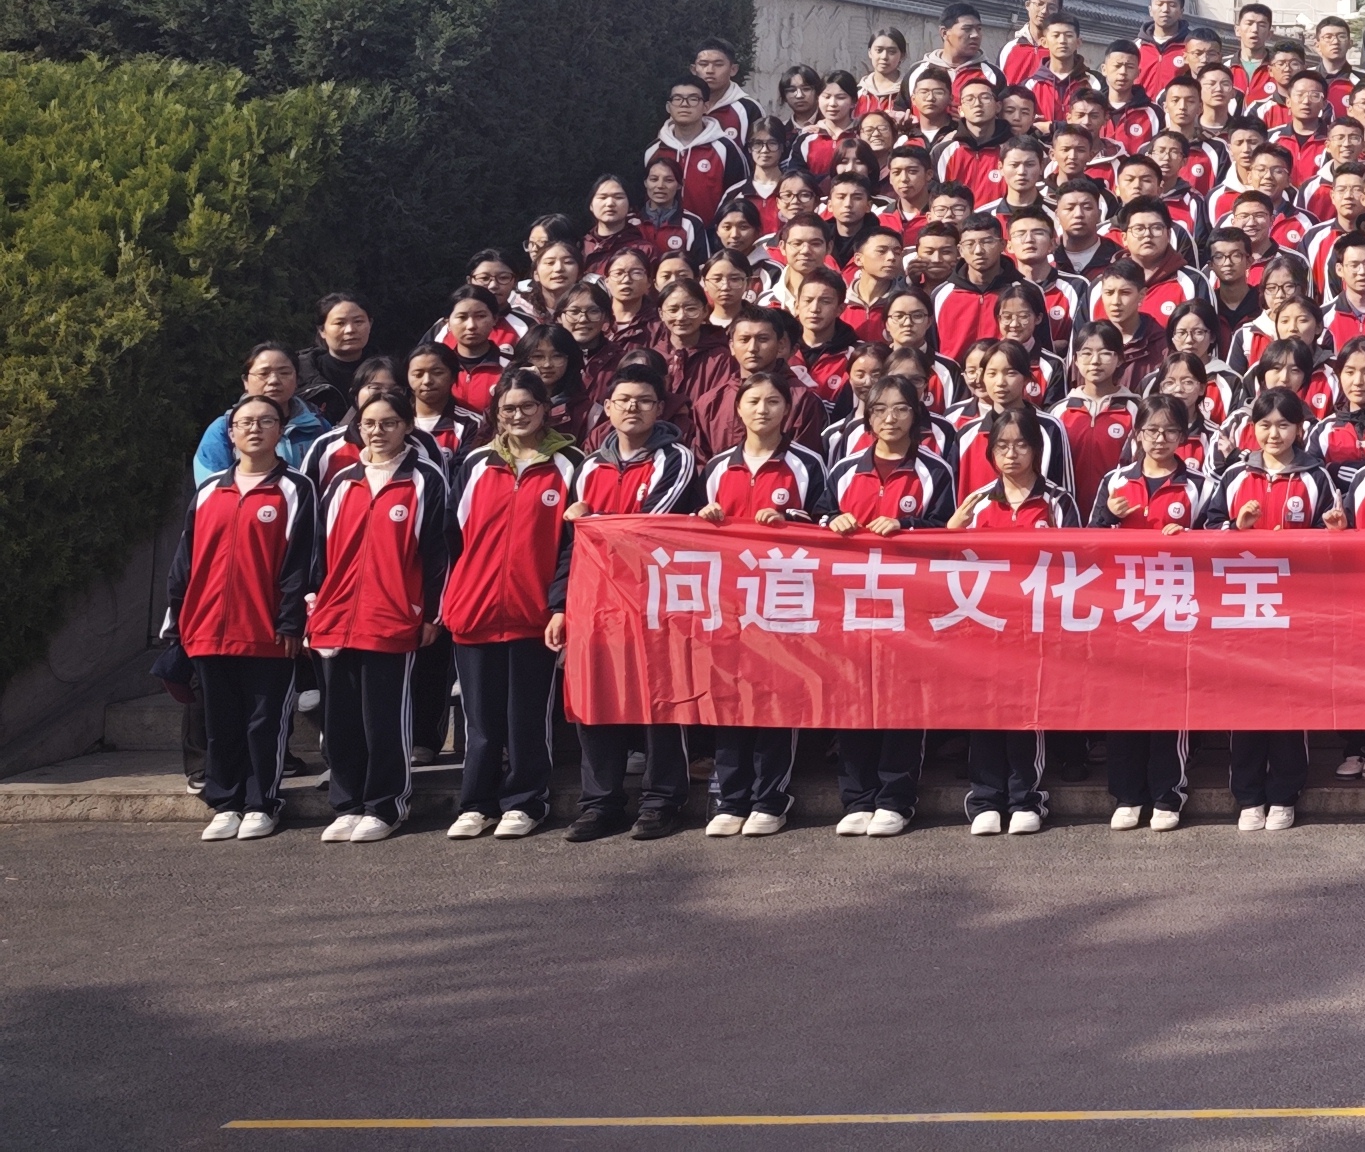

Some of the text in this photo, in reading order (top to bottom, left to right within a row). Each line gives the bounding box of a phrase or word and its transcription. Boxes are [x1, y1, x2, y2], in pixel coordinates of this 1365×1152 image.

[646, 547, 1291, 634] 问道古文化瑰宝
